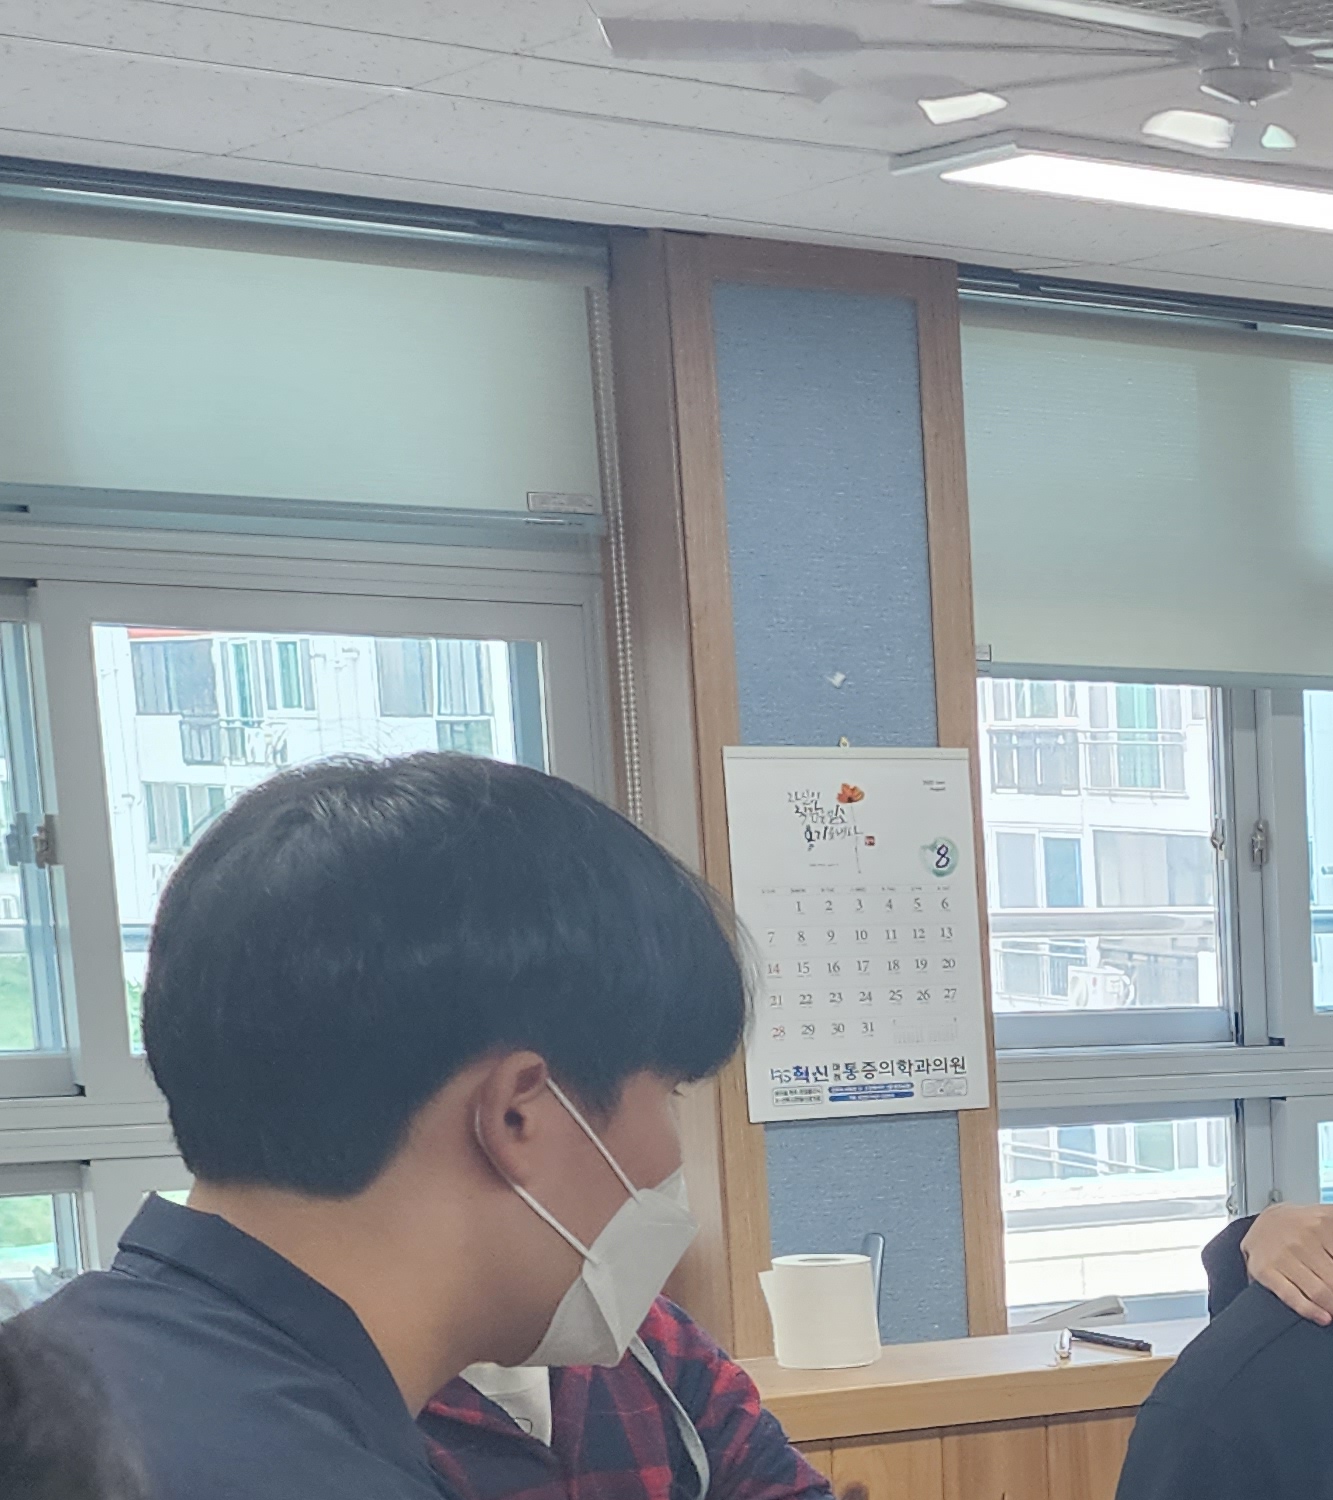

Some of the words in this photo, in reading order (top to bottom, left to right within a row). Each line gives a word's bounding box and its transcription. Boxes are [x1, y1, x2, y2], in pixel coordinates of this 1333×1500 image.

[935, 844, 949, 868] 8
[797, 901, 802, 911] 1
[826, 901, 833, 911] 2
[856, 899, 863, 911] 3
[885, 900, 893, 910] 4
[914, 898, 921, 910] 5
[941, 898, 949, 909] 6
[768, 932, 775, 942] 7
[798, 931, 805, 942] 8
[827, 930, 835, 941] 9
